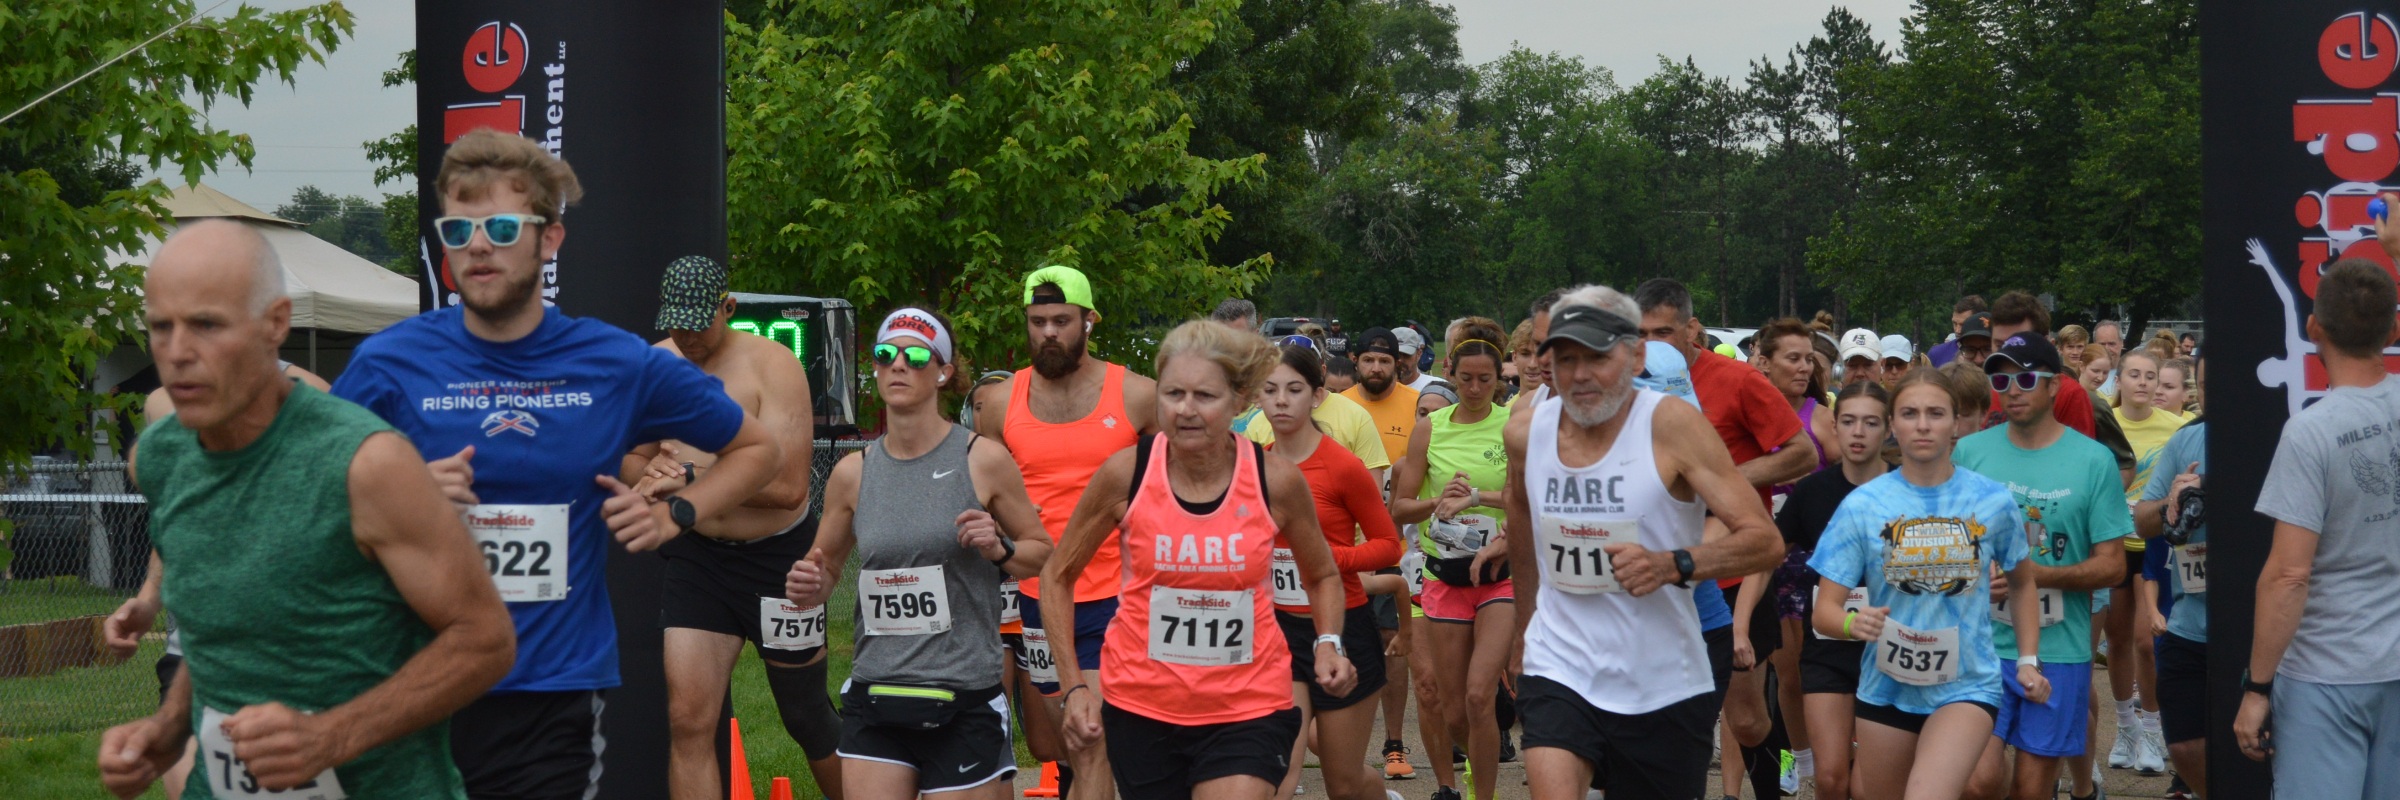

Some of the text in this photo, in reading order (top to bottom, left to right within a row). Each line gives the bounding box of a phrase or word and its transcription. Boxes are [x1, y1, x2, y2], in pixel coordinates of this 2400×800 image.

[447, 379, 567, 390] PIONEER LEADERSHIP
[463, 386, 551, 396] INSTITUTE
[423, 392, 593, 411] RISING PIONEERS
[2336, 423, 2382, 449] MILES
[1545, 475, 1625, 505] RARC
[2028, 488, 2071, 500] Marathon
[1560, 524, 1610, 537] TrackSide
[1155, 532, 1245, 564] RARC
[1902, 535, 1964, 547] DIVISION 3
[480, 540, 551, 576] 622
[1893, 547, 1974, 563] Track & Field
[1230, 563, 1246, 572] CLUB
[875, 574, 919, 585] TrackSide
[868, 591, 937, 619] 7596
[1177, 596, 1231, 608] TrackSide
[770, 612, 824, 638] 7576
[1161, 614, 1243, 648] 7112
[1886, 640, 1949, 672] 7537
